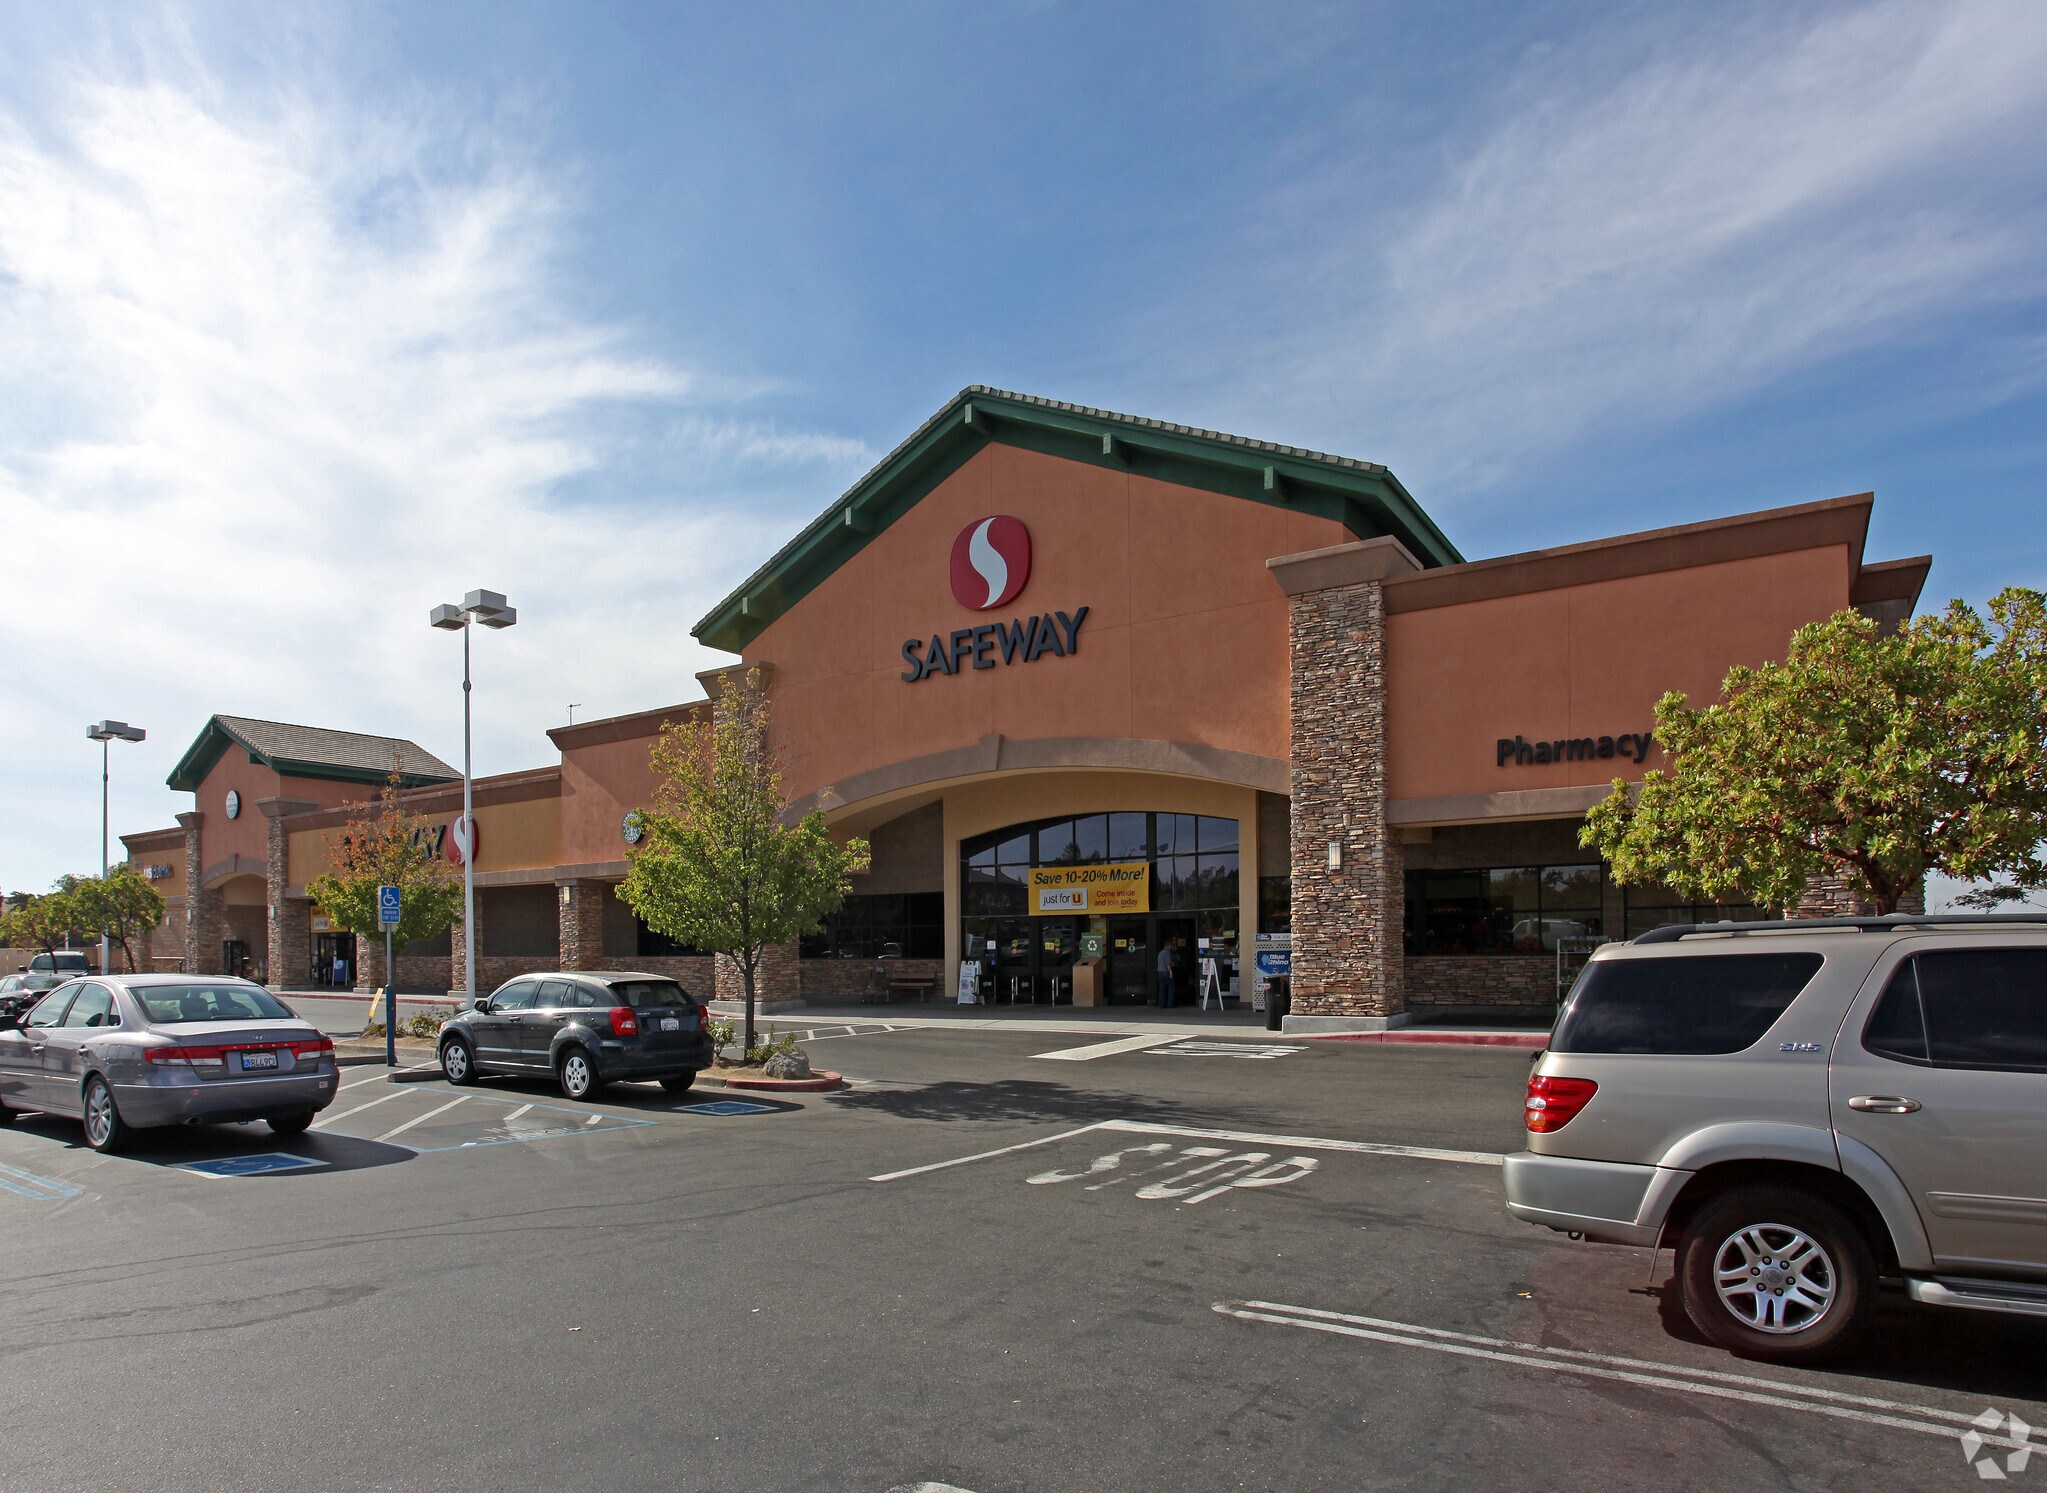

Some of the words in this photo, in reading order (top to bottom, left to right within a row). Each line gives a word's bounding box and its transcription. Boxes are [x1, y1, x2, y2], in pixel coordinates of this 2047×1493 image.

[901, 606, 1089, 683] SAFEWAY
[1496, 732, 1652, 767] Pharmacy
[1034, 872, 1062, 885] Save
[1065, 870, 1107, 883] 10-20%
[1109, 867, 1145, 881] More!
[1043, 894, 1058, 906] just
[1059, 893, 1070, 904] for
[1072, 893, 1081, 904] u
[1096, 890, 1115, 898] Come
[1116, 889, 1136, 897] inside
[1107, 898, 1120, 907] join
[1120, 898, 1138, 907] today
[1026, 1143, 1319, 1204] STOP
